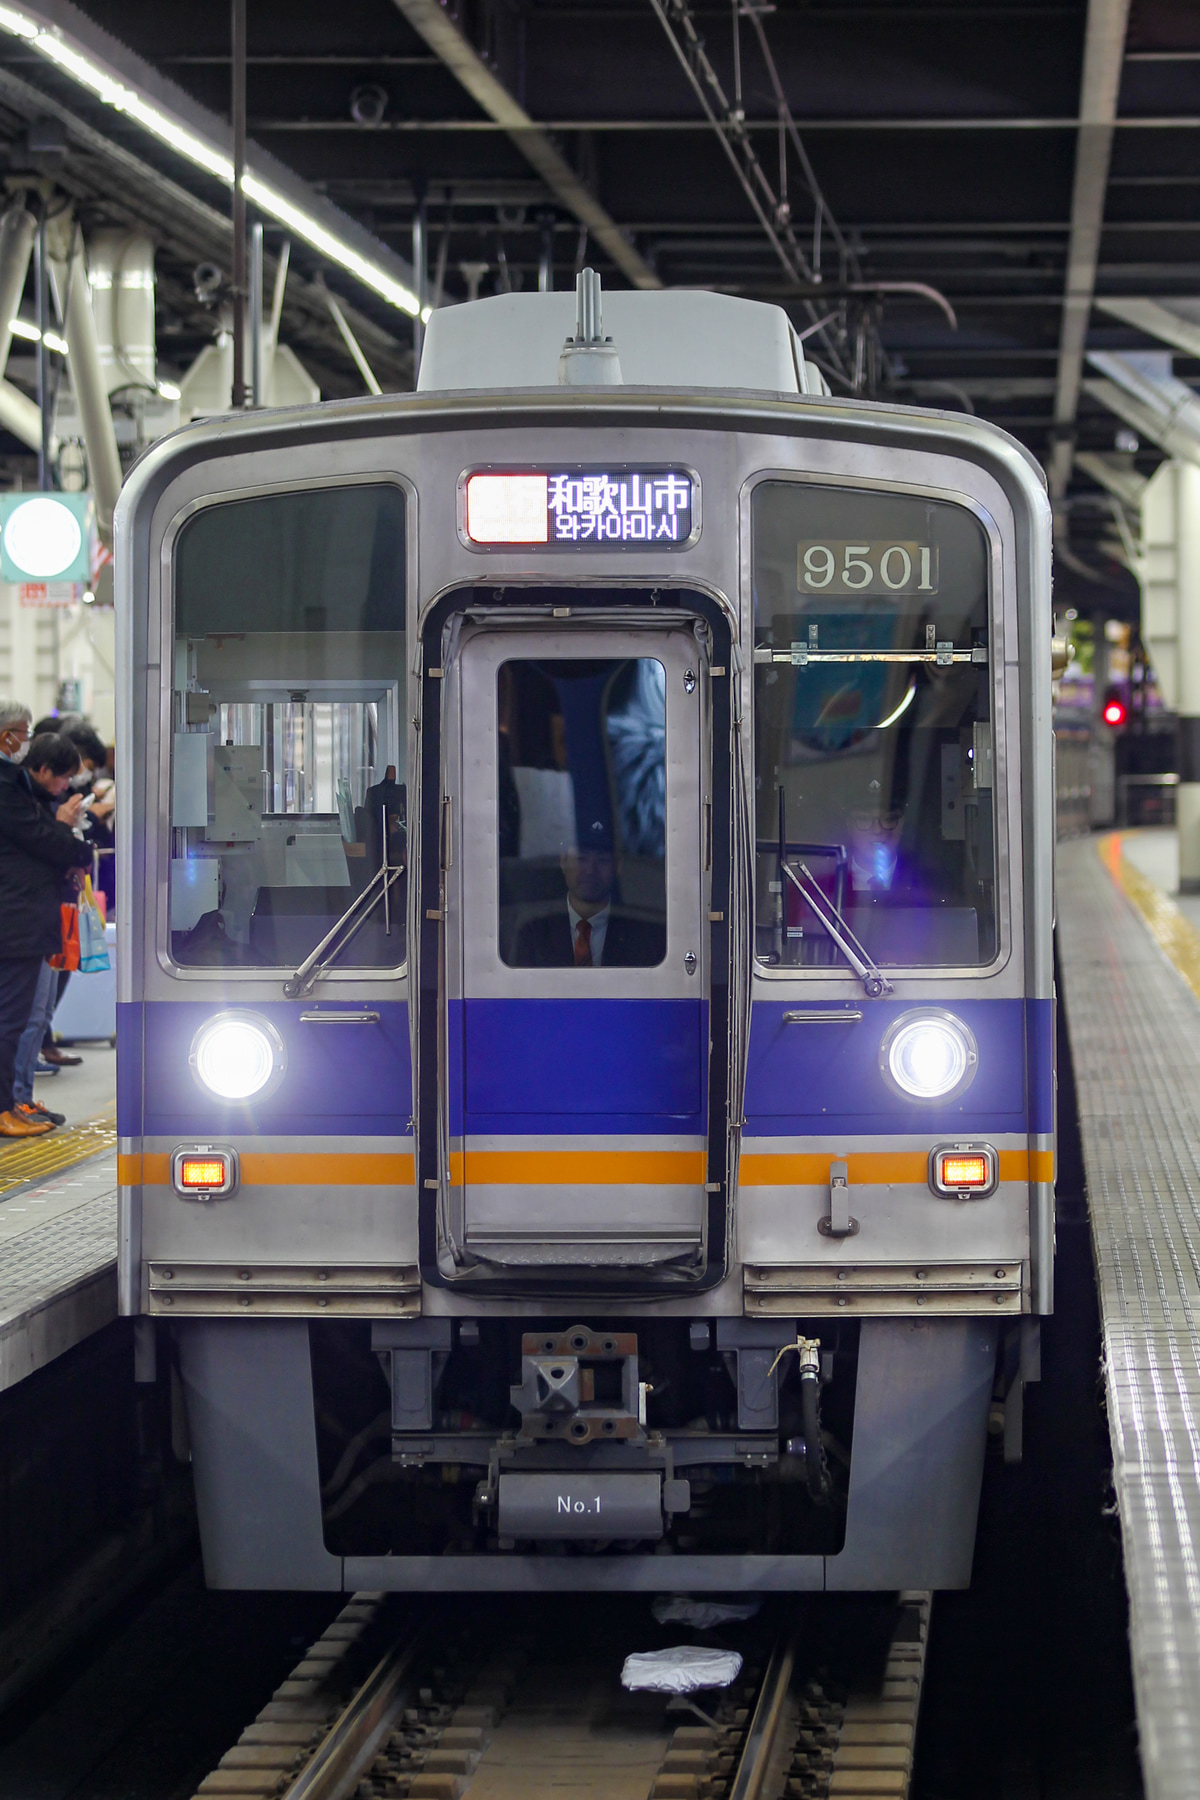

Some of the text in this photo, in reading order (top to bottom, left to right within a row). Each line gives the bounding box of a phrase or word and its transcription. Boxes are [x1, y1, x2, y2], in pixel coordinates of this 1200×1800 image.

[547, 474, 690, 515] 和歌山市
[555, 515, 678, 540] 와카야마시
[803, 545, 934, 590] 9501
[557, 1495, 601, 1513] No.1
